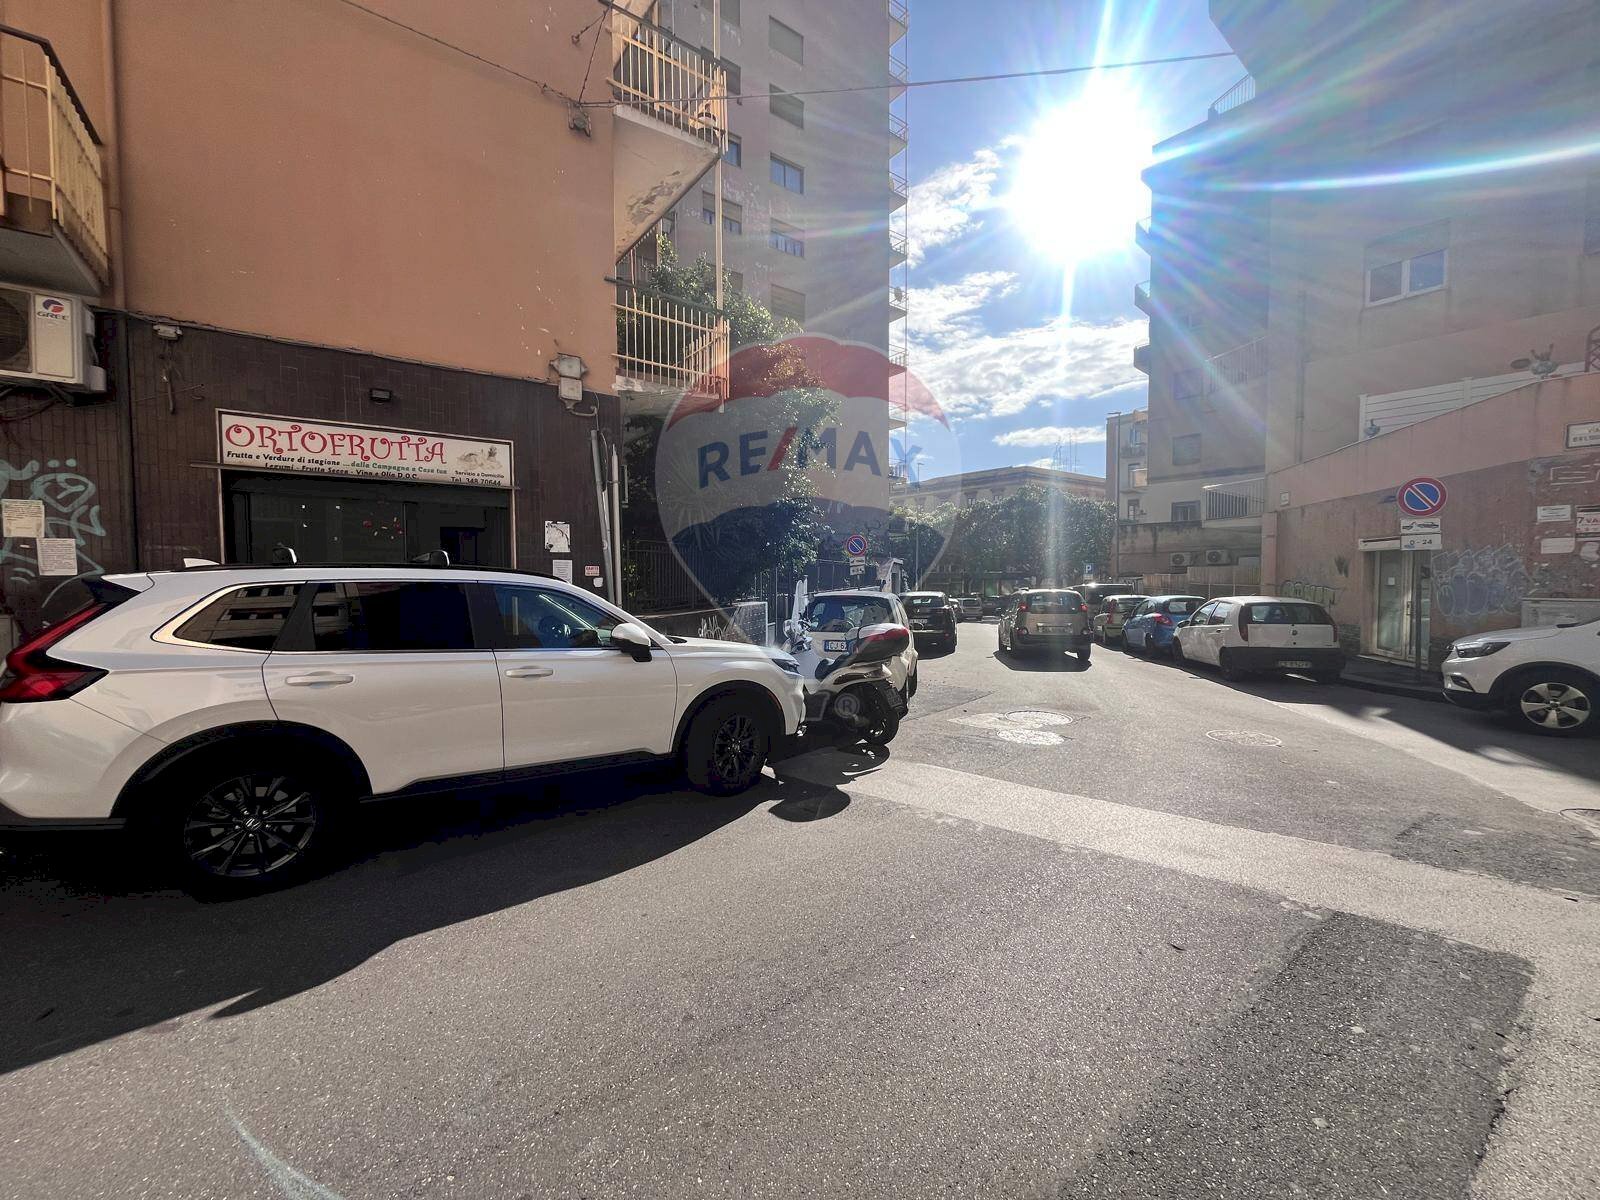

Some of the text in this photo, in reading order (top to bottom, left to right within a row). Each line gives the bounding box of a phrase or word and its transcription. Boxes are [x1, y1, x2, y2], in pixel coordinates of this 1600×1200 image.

[225, 424, 447, 464] ORTOFRUTTA
[226, 450, 253, 460] Frutta
[263, 453, 295, 463] Verdure
[297, 456, 306, 464] di
[307, 457, 341, 467] stagione
[372, 462, 410, 472] Campagna
[418, 466, 435, 474] Casa
[264, 462, 294, 471] Legumi
[302, 465, 326, 473] Frutta
